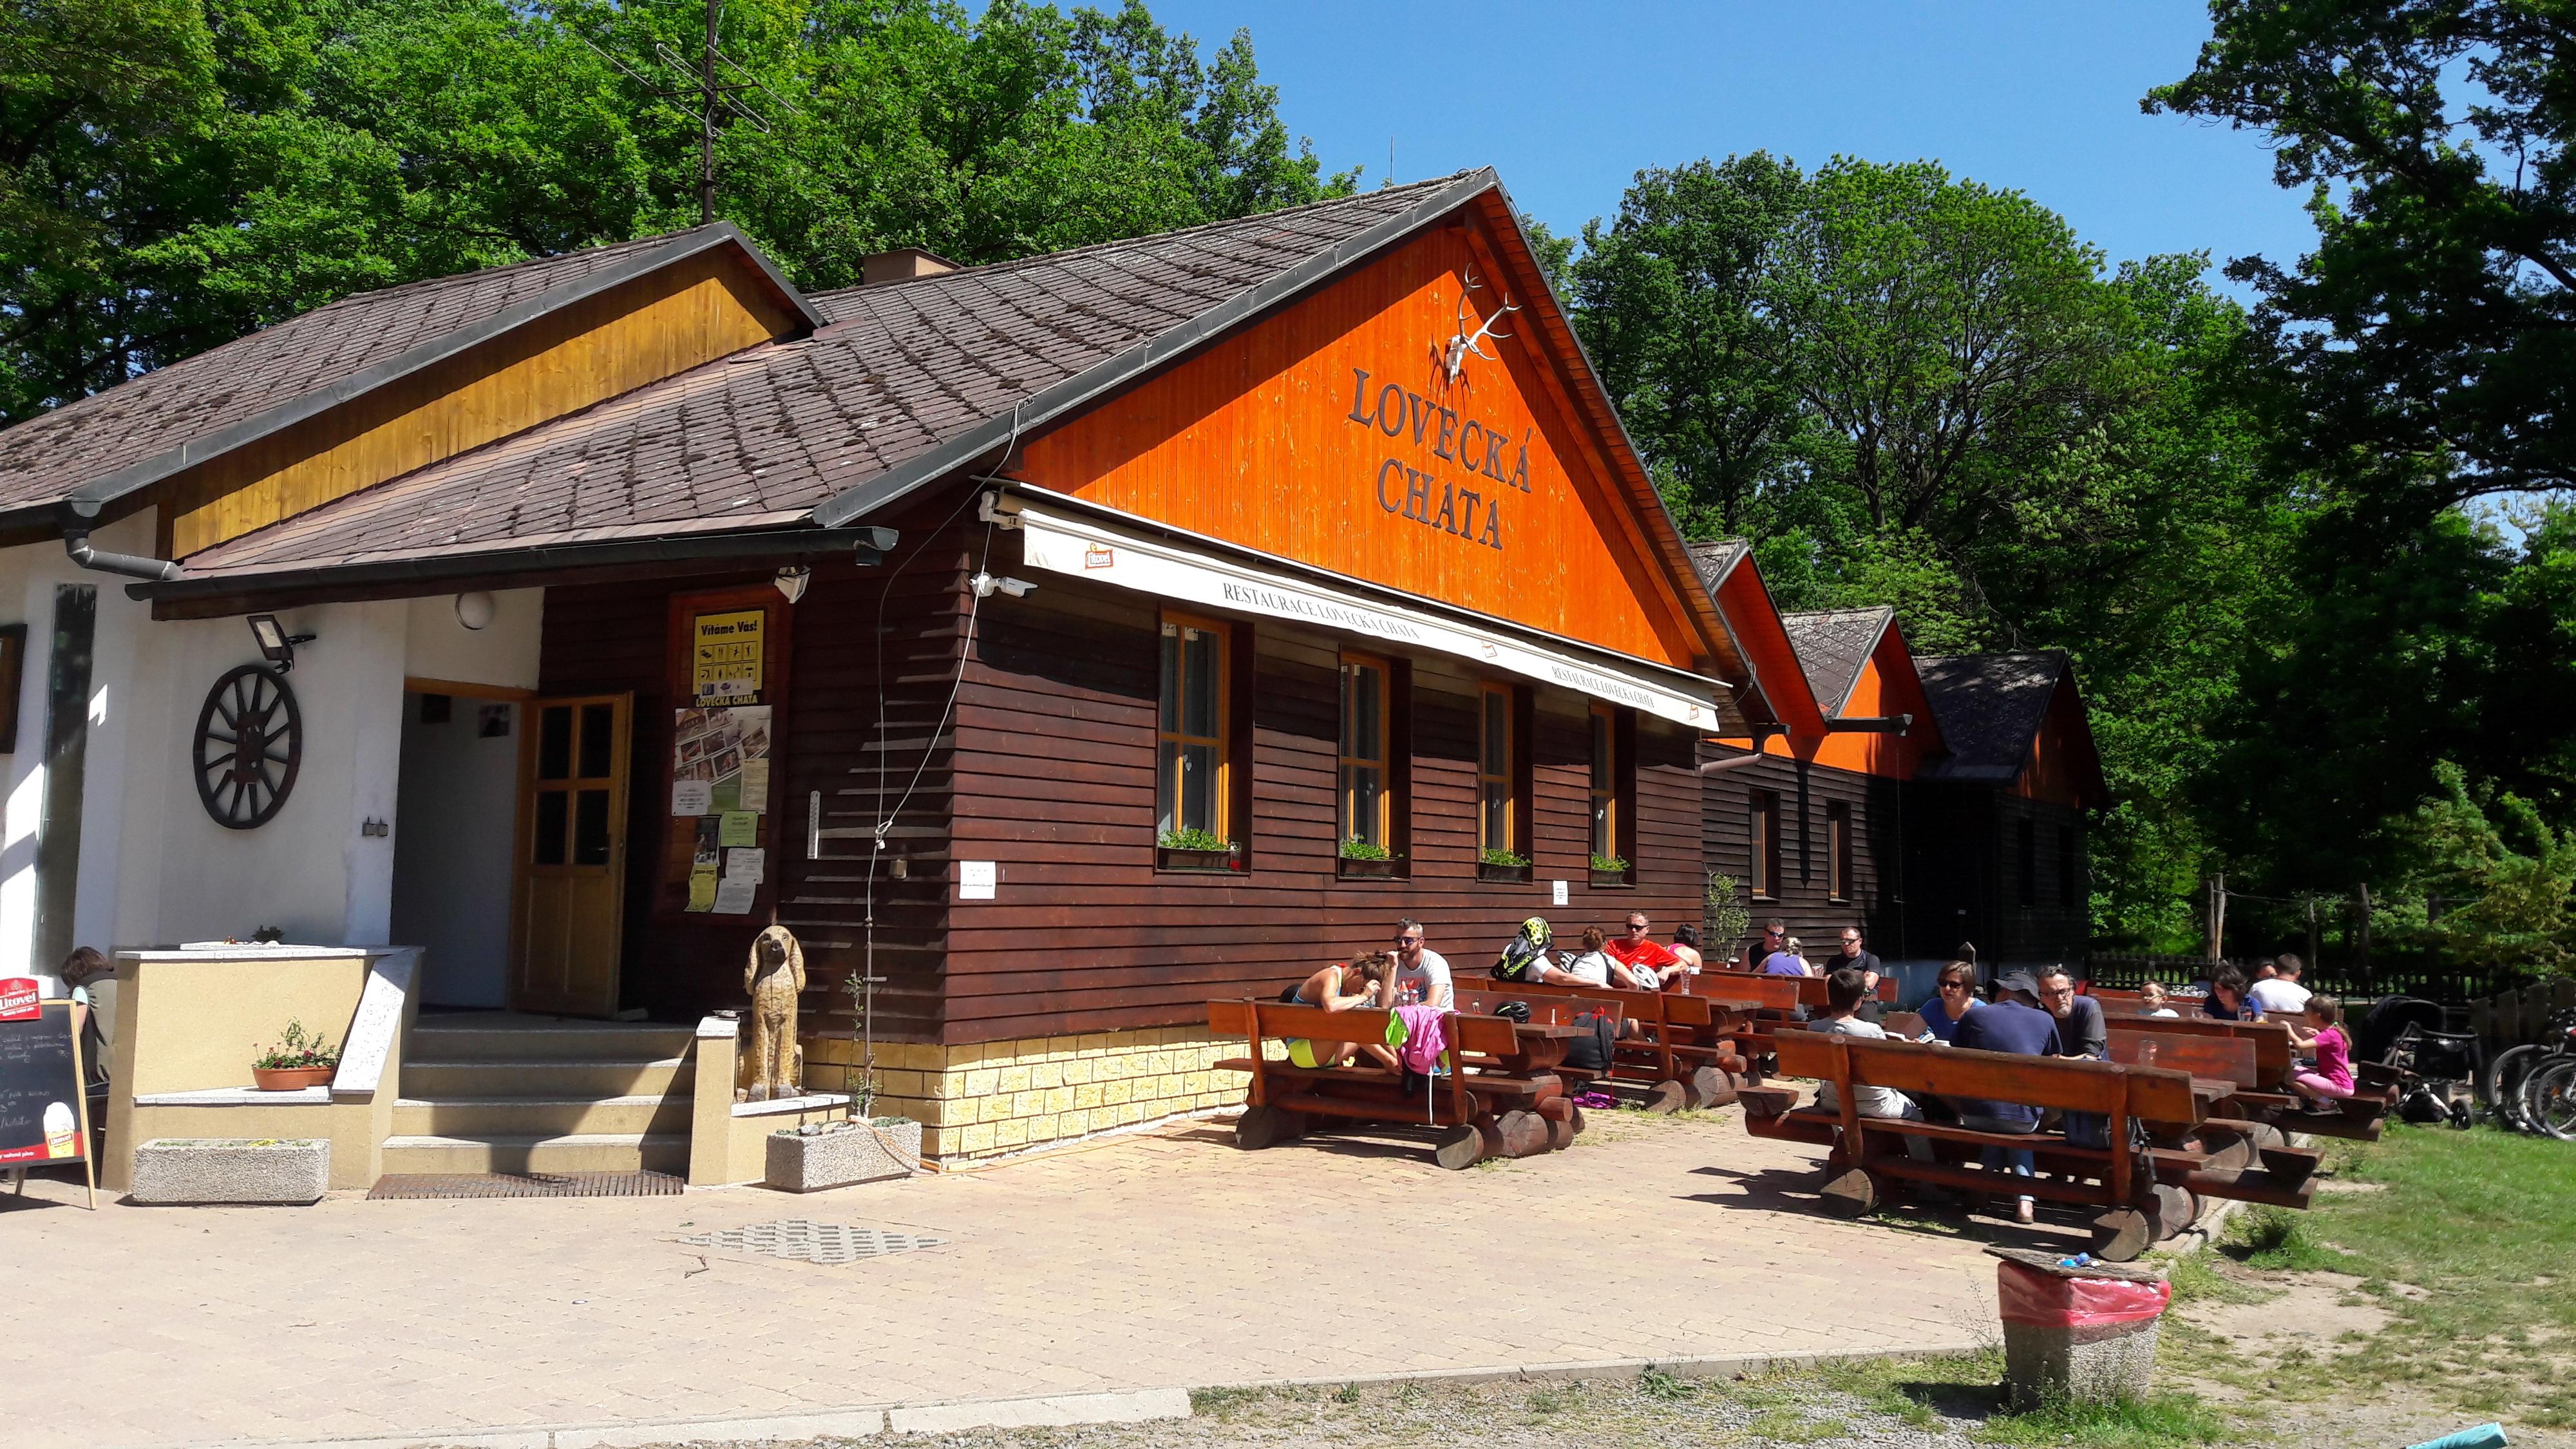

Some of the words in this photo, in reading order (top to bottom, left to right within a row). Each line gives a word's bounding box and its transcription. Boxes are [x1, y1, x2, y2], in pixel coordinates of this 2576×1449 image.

[1348, 367, 1531, 493] LOVECKÁ
[1378, 459, 1502, 550] CHATA
[1223, 582, 1318, 616] RESTAURACE
[1379, 619, 1421, 639] CHATA
